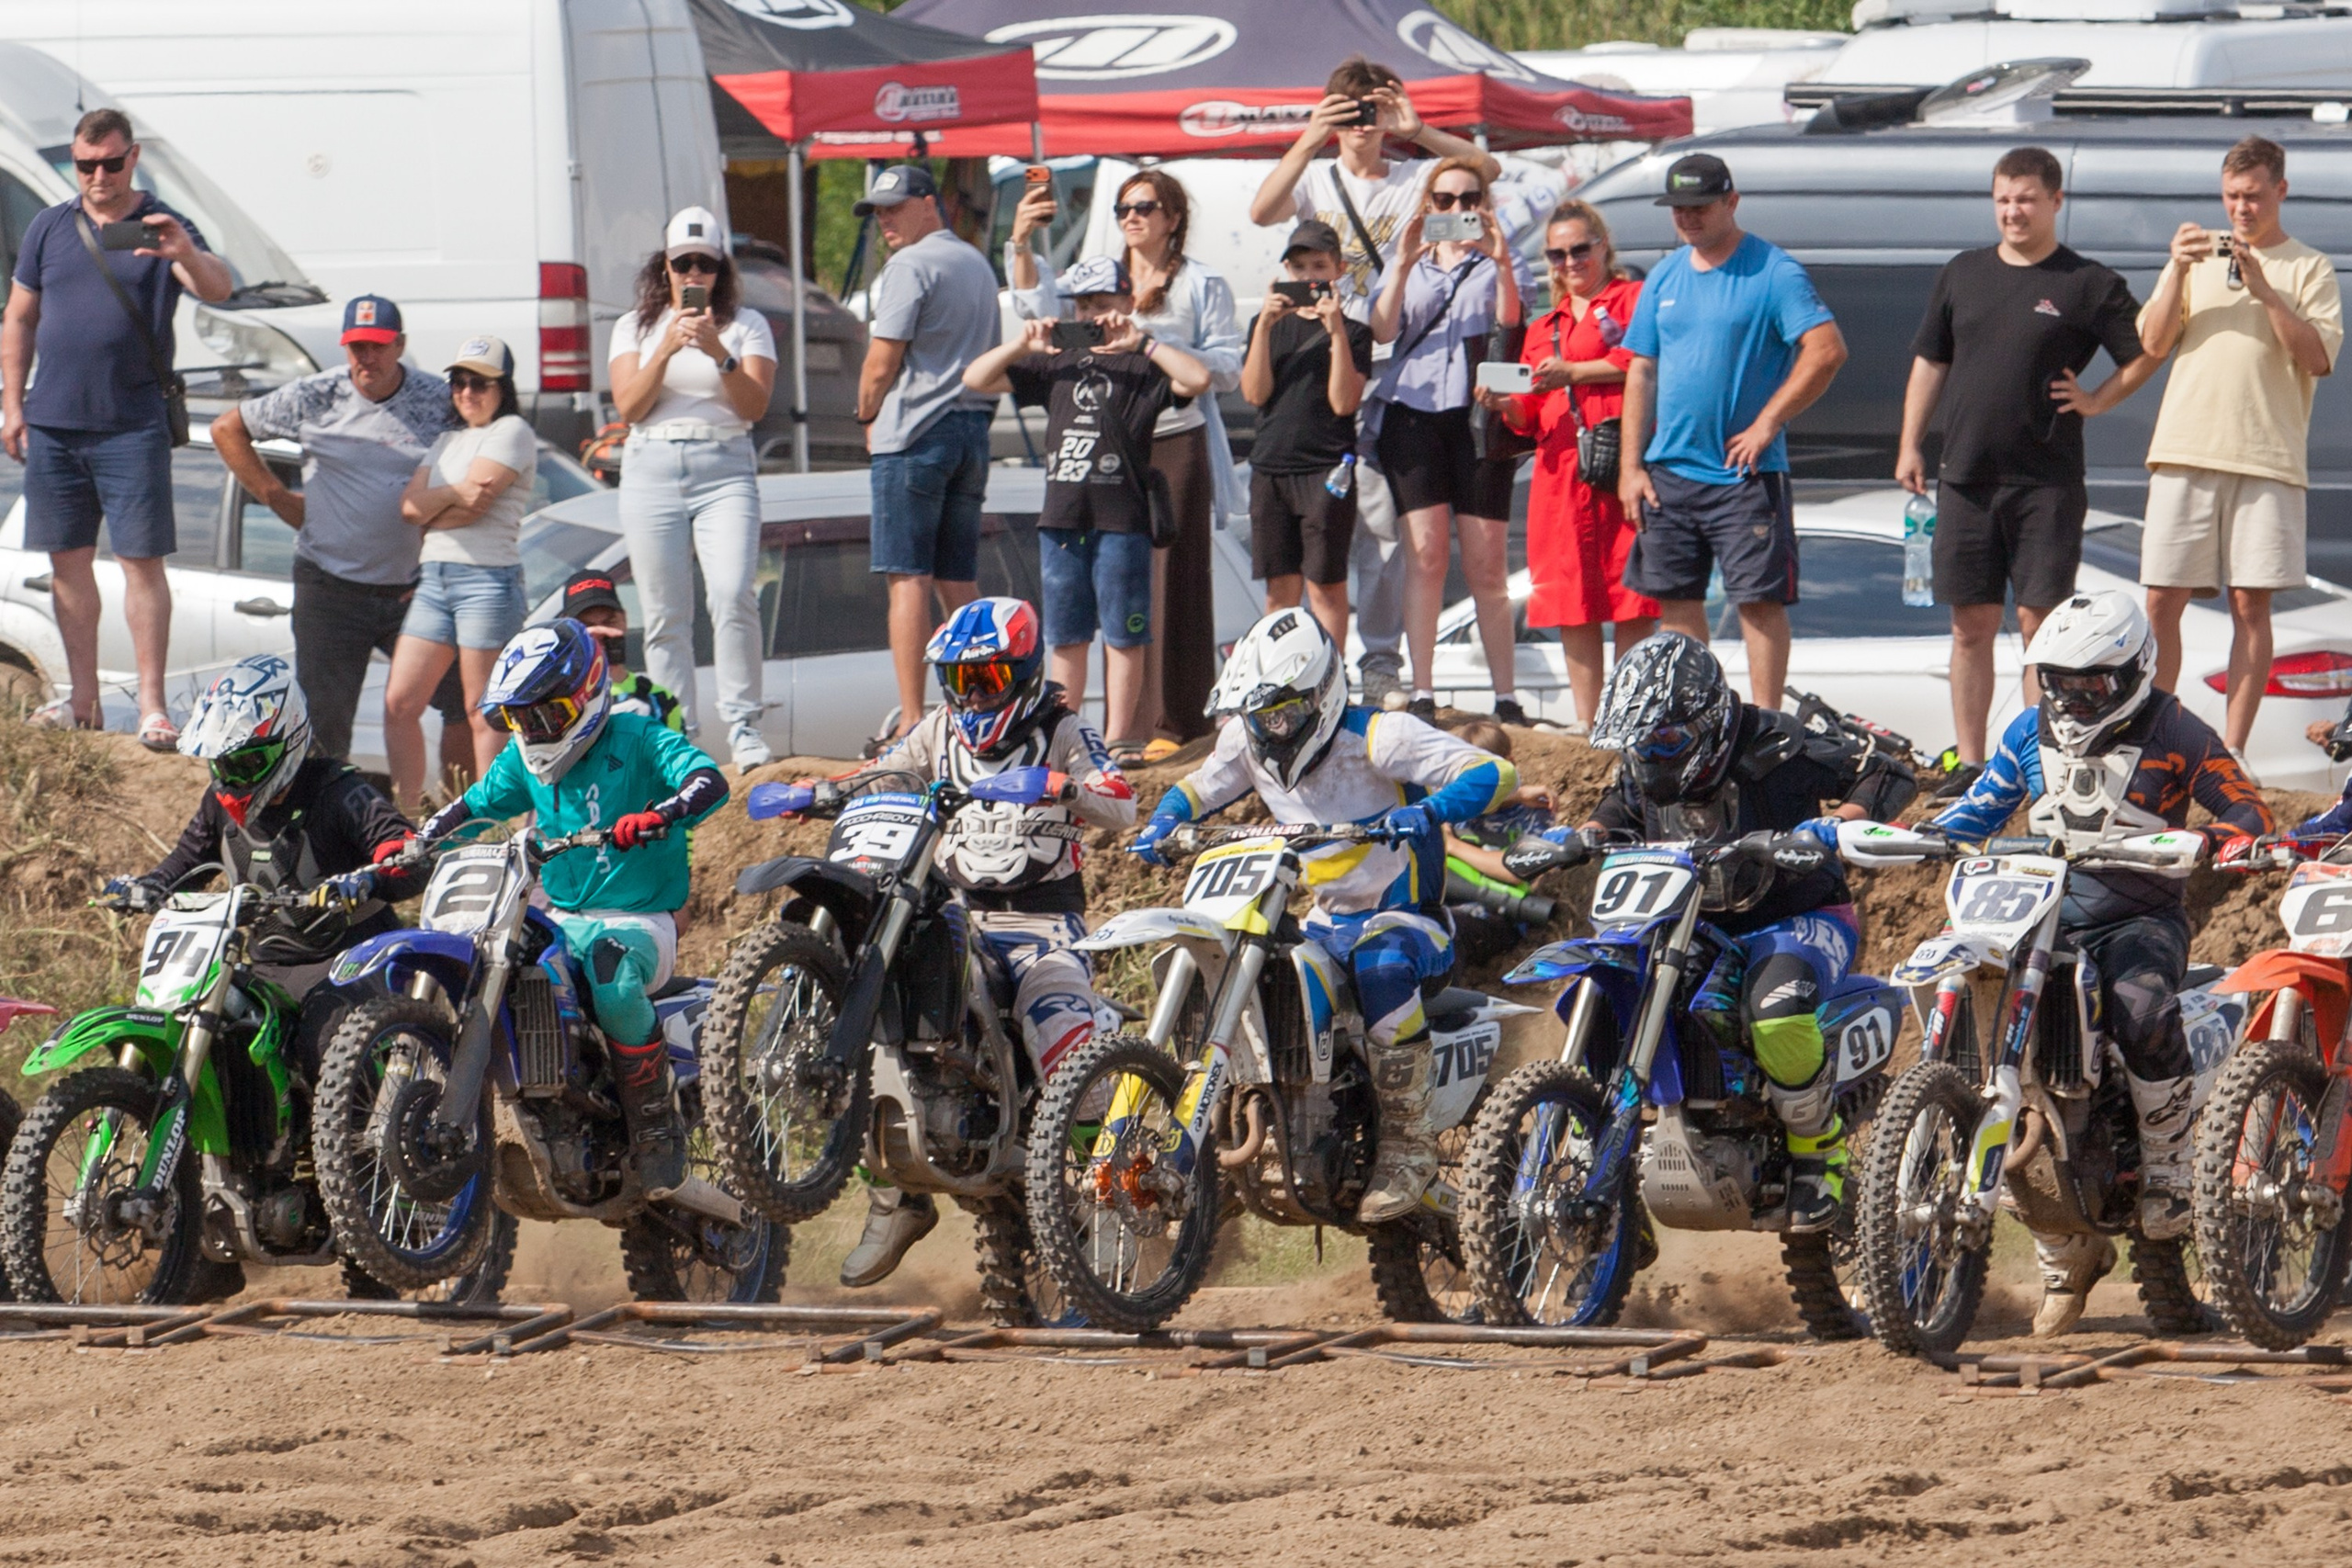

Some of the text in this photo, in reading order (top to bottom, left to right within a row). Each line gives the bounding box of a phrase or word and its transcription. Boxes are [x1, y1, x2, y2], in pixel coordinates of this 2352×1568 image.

[1057, 460, 1092, 482] 23
[1059, 436, 1095, 458] 20
[829, 820, 920, 863] 39
[431, 864, 504, 919] 2
[1185, 853, 1275, 905] 705
[1594, 871, 1674, 915] 91
[1960, 879, 2045, 923] 85
[2294, 887, 2352, 936] 6
[141, 931, 209, 978] 94
[125, 1013, 165, 1023] DUNLOP
[1432, 1034, 1495, 1089] 705
[1847, 1015, 1886, 1071] 91
[1197, 1060, 1223, 1117] MOTOREX
[151, 1106, 187, 1192] DUNLOP
